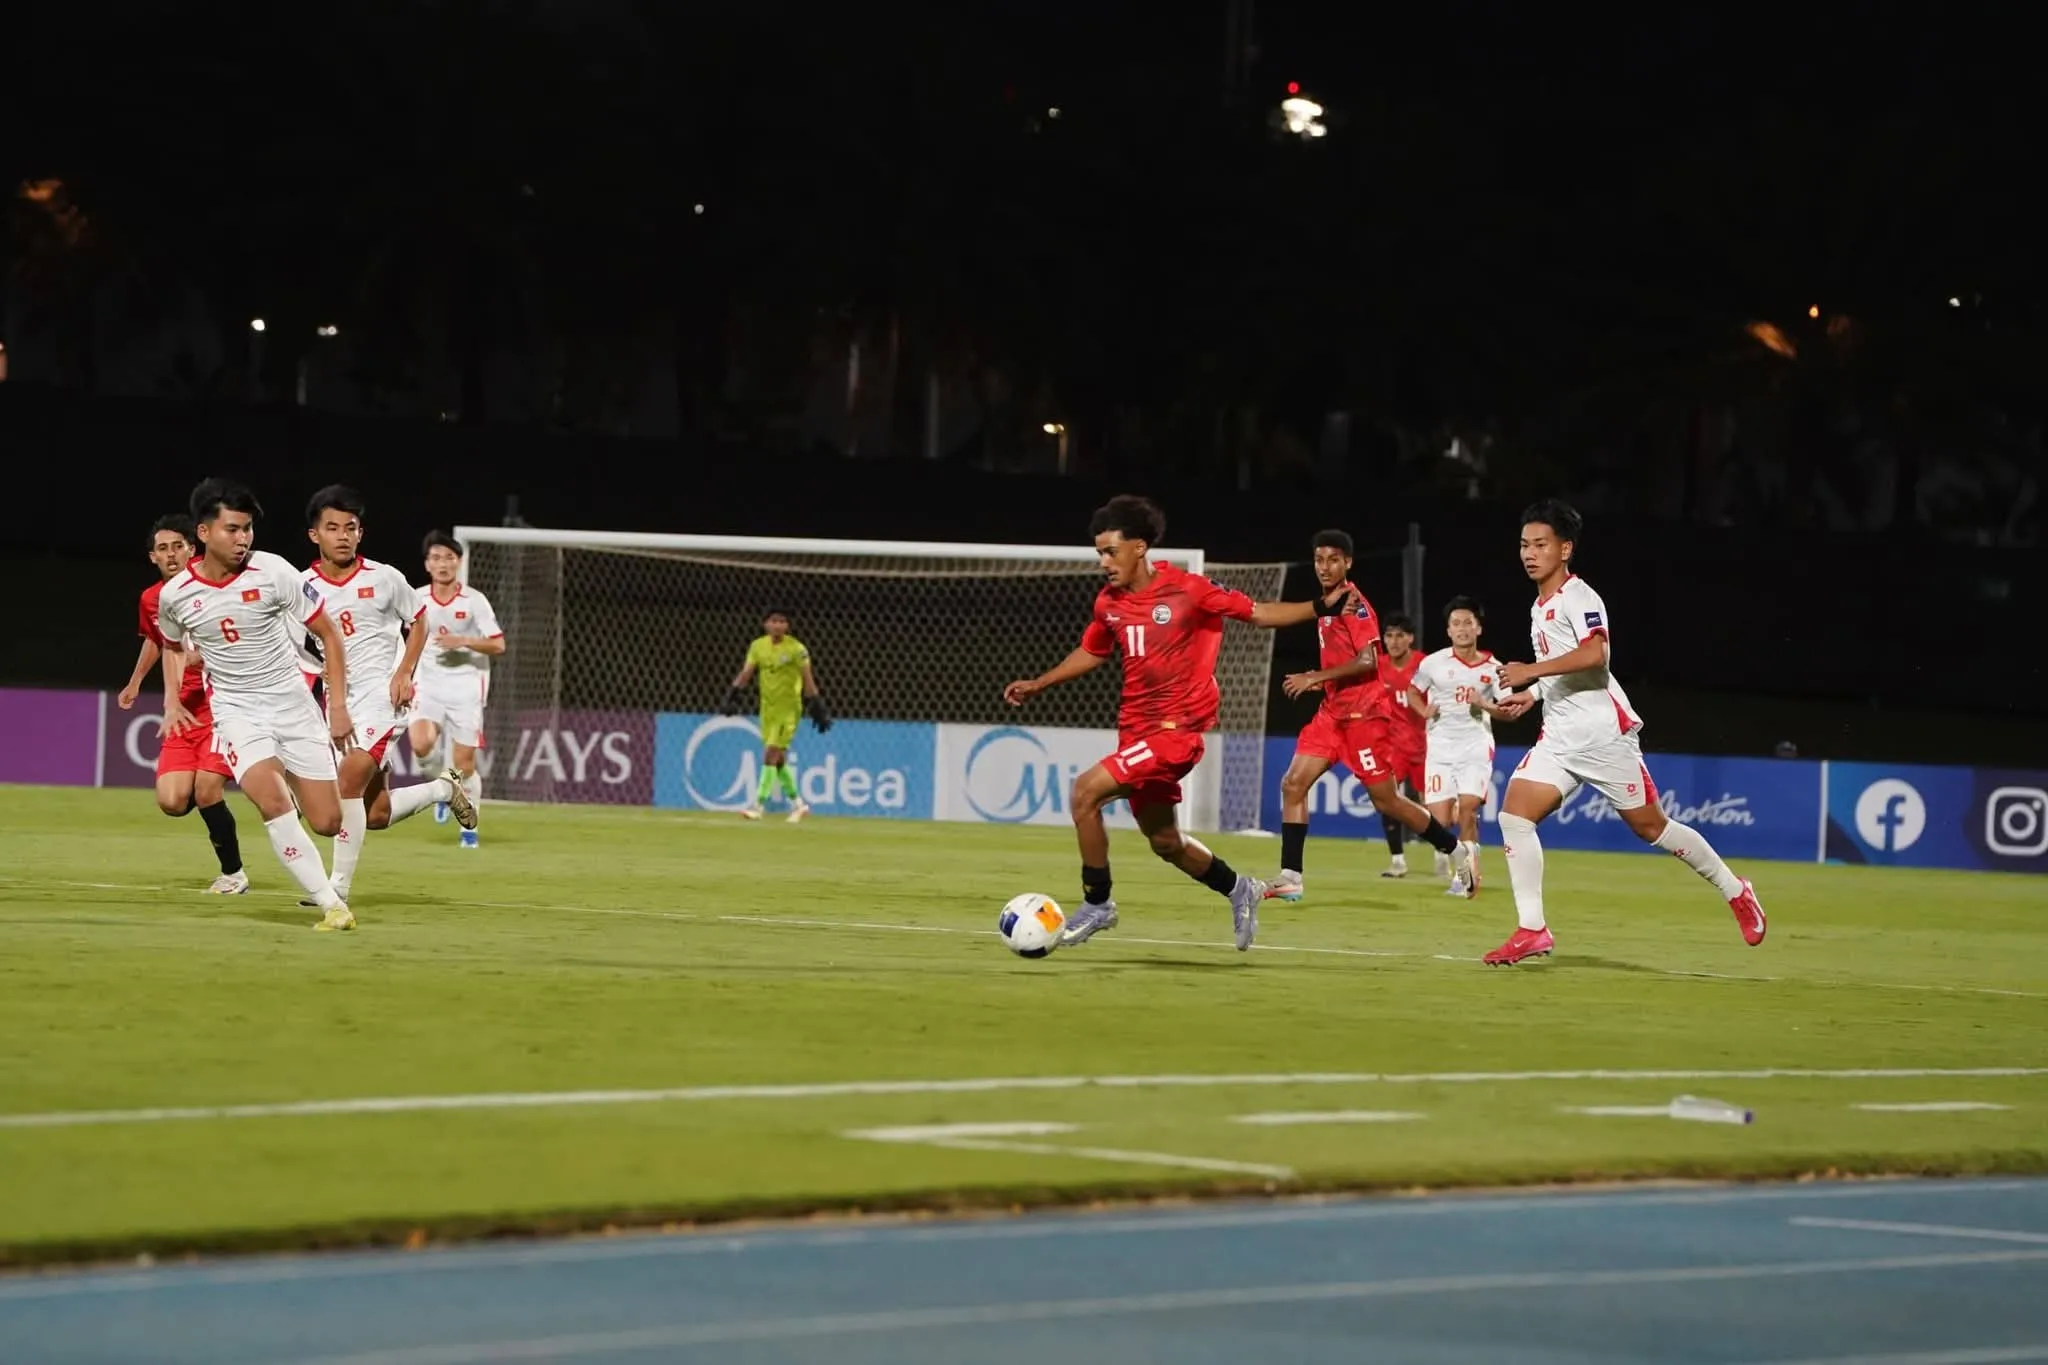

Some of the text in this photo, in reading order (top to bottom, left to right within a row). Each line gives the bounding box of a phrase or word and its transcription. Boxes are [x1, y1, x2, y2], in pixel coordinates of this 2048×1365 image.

[219, 617, 240, 643] 6
[340, 610, 355, 636] 8
[1126, 625, 1145, 656] 11
[1395, 690, 1408, 708] 4
[1119, 740, 1154, 767] 11
[1357, 747, 1377, 771] 6
